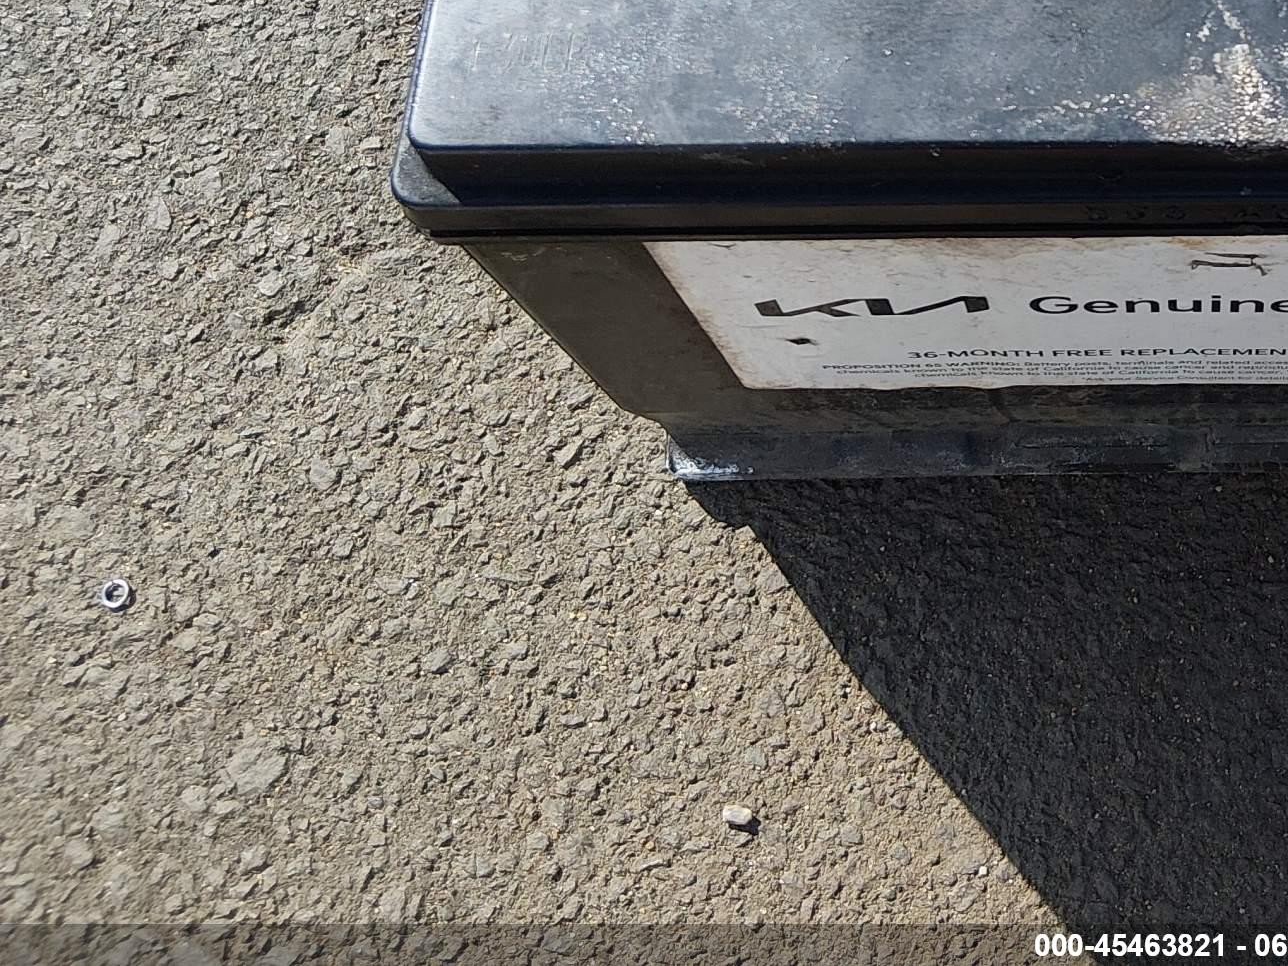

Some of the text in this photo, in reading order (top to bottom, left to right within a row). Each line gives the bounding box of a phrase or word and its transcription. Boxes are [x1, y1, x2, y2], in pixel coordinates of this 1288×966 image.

[754, 295, 991, 318] KIA
[907, 348, 1045, 359] 36-MONTH
[1051, 349, 1113, 358] FREE
